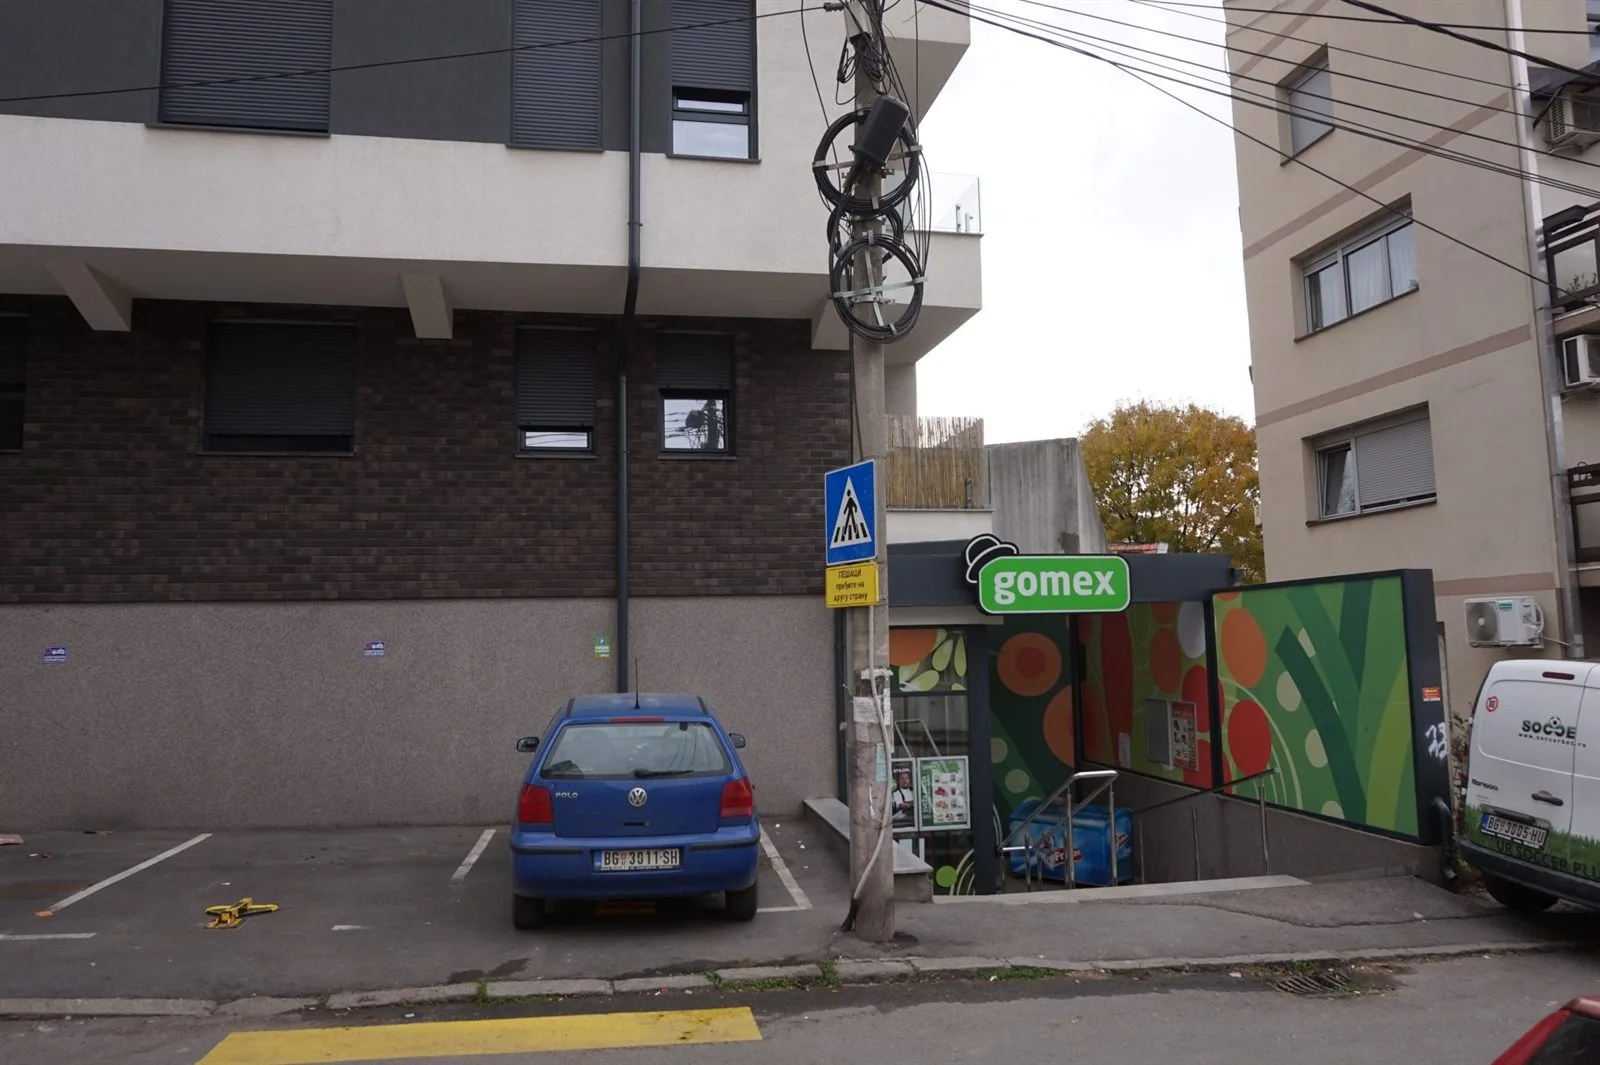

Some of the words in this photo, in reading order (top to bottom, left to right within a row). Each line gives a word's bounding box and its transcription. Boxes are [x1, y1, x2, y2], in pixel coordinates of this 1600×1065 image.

[993, 570, 1116, 605] gomex
[555, 791, 579, 799] POLO
[1488, 817, 1500, 833] BG
[604, 852, 619, 865] BG
